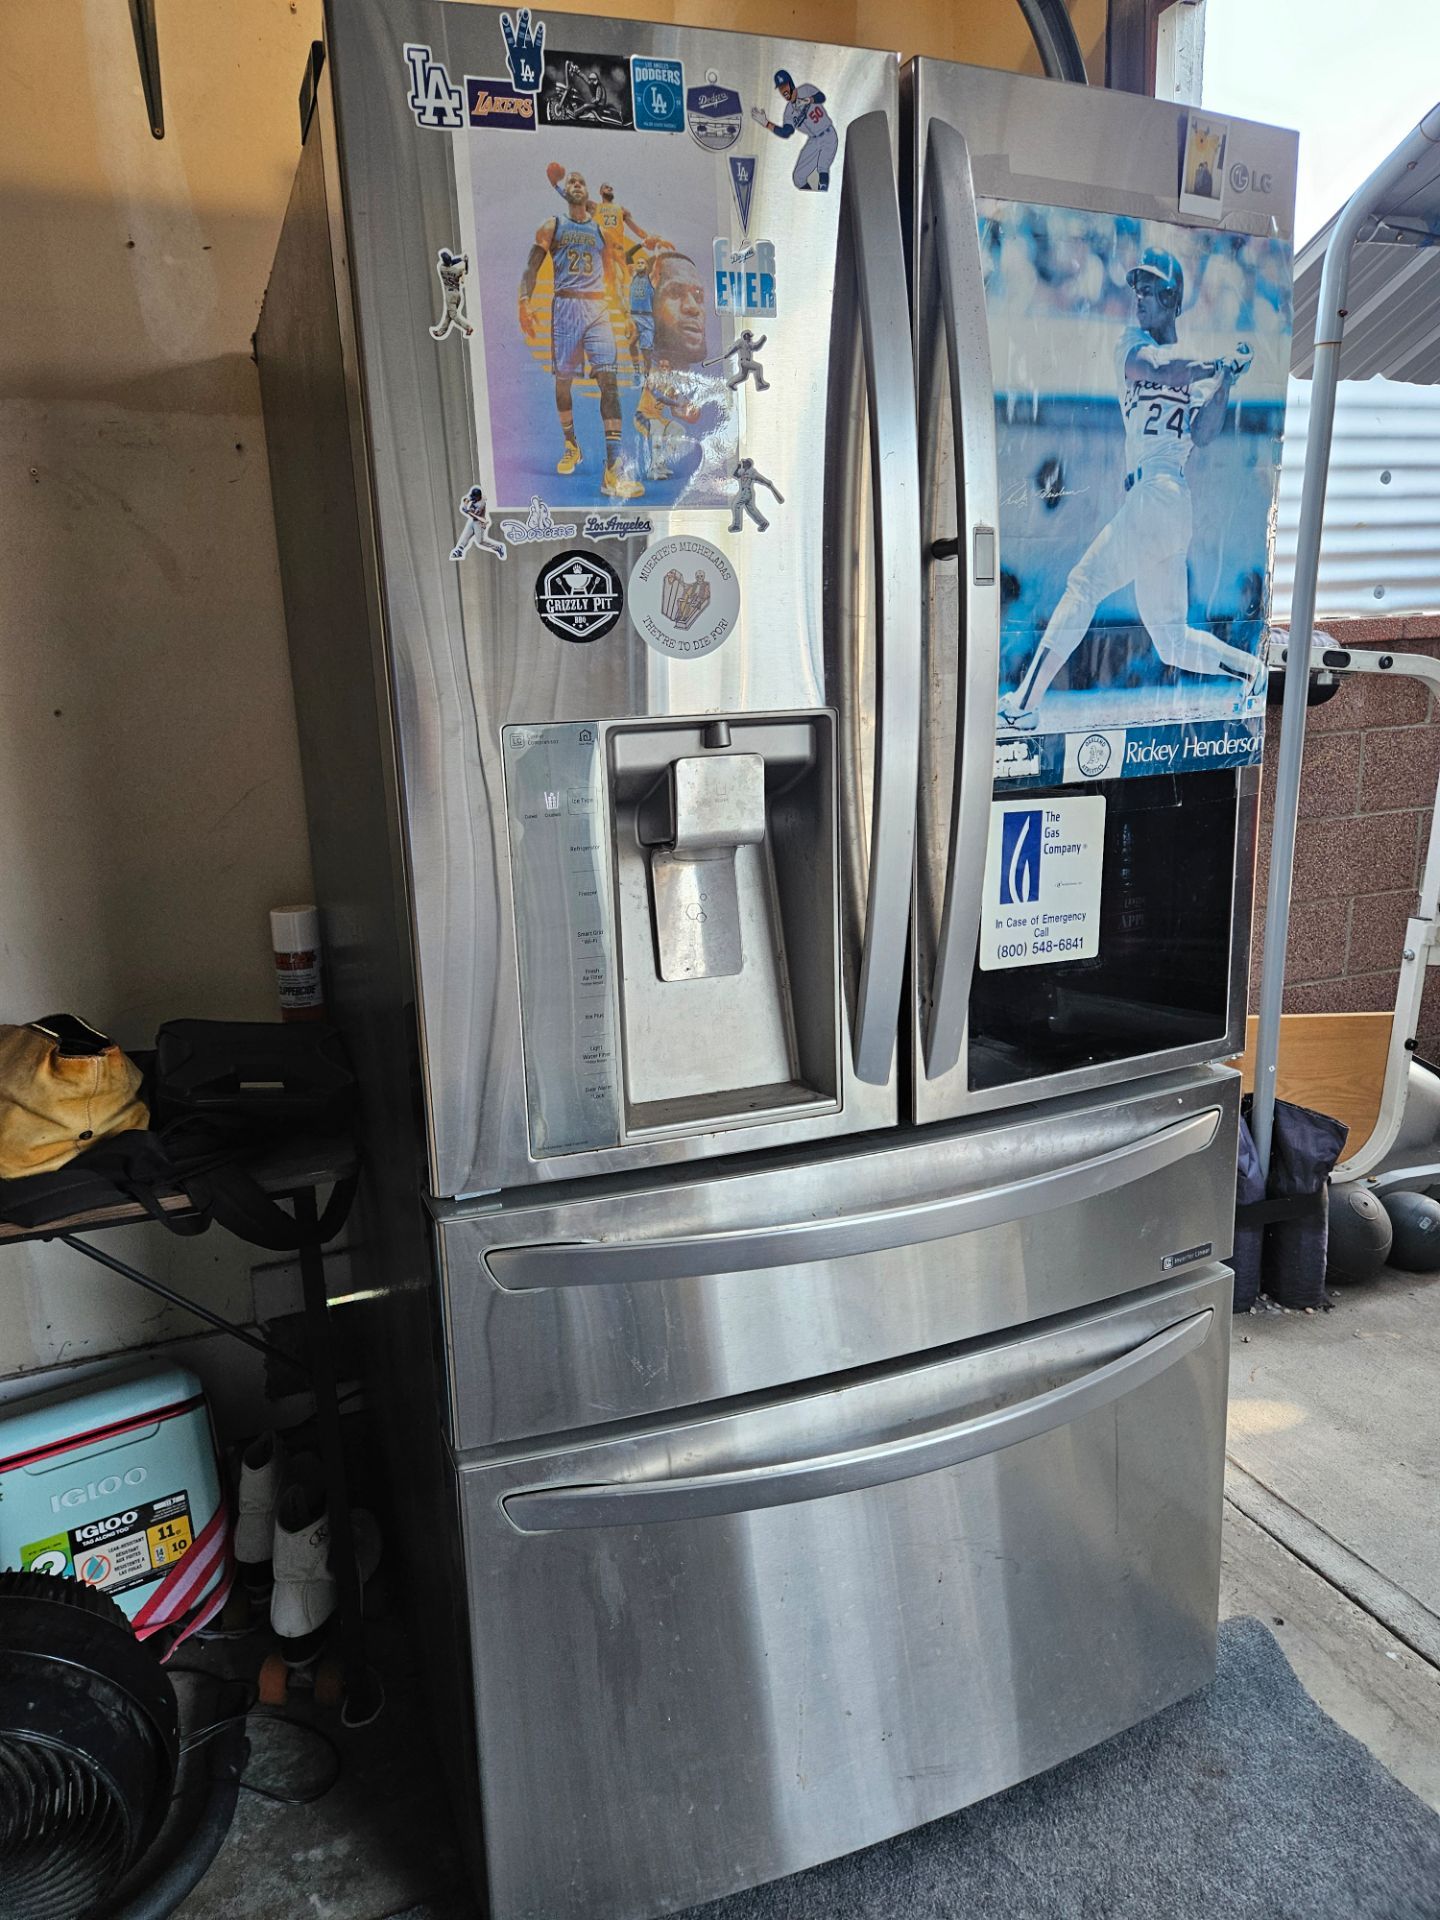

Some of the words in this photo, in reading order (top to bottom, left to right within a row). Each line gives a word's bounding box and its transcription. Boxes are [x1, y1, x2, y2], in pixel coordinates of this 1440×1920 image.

[520, 59, 535, 82] LA
[635, 67, 681, 86] DODGERS
[407, 47, 463, 128] LA
[471, 91, 533, 118] LAKERS
[651, 86, 667, 114] LA
[698, 92, 728, 109] Dodgers
[808, 106, 824, 124] 50
[736, 162, 749, 181] LA
[603, 214, 617, 226] 23
[567, 249, 594, 276] 23
[716, 271, 775, 308] EVER
[1144, 403, 1184, 439] 24
[586, 518, 604, 531] Los
[604, 516, 651, 537] Angeles
[639, 543, 678, 582] MUERTE'S
[679, 542, 732, 581] MICHELADAS
[546, 598, 589, 613] GRIZZLY
[593, 597, 613, 612] PIT
[574, 616, 587, 624] BBQ
[678, 640, 690, 651] TO
[693, 636, 711, 650] DIE
[710, 618, 729, 640] FOR!
[1126, 738, 1179, 766] Rickey
[1183, 732, 1264, 759] Henderson
[1046, 811, 1061, 822] The
[1044, 827, 1060, 839] Gas
[1043, 843, 1082, 856] Company
[995, 919, 1003, 929] In
[1006, 917, 1027, 928] Case
[1030, 915, 1040, 926] of
[1042, 912, 1087, 924] Emergency
[1034, 927, 1050, 938] Call
[997, 942, 1028, 960] (800)
[1032, 937, 1084, 955] 548-6841
[50, 1467, 148, 1513] IGLOO
[75, 1511, 138, 1542] IGLOO
[82, 1539, 95, 1547] TAG
[95, 1531, 116, 1543] ALONG
[116, 1526, 129, 1535] TOO
[158, 1524, 175, 1540] 11
[172, 1539, 187, 1552] 10
